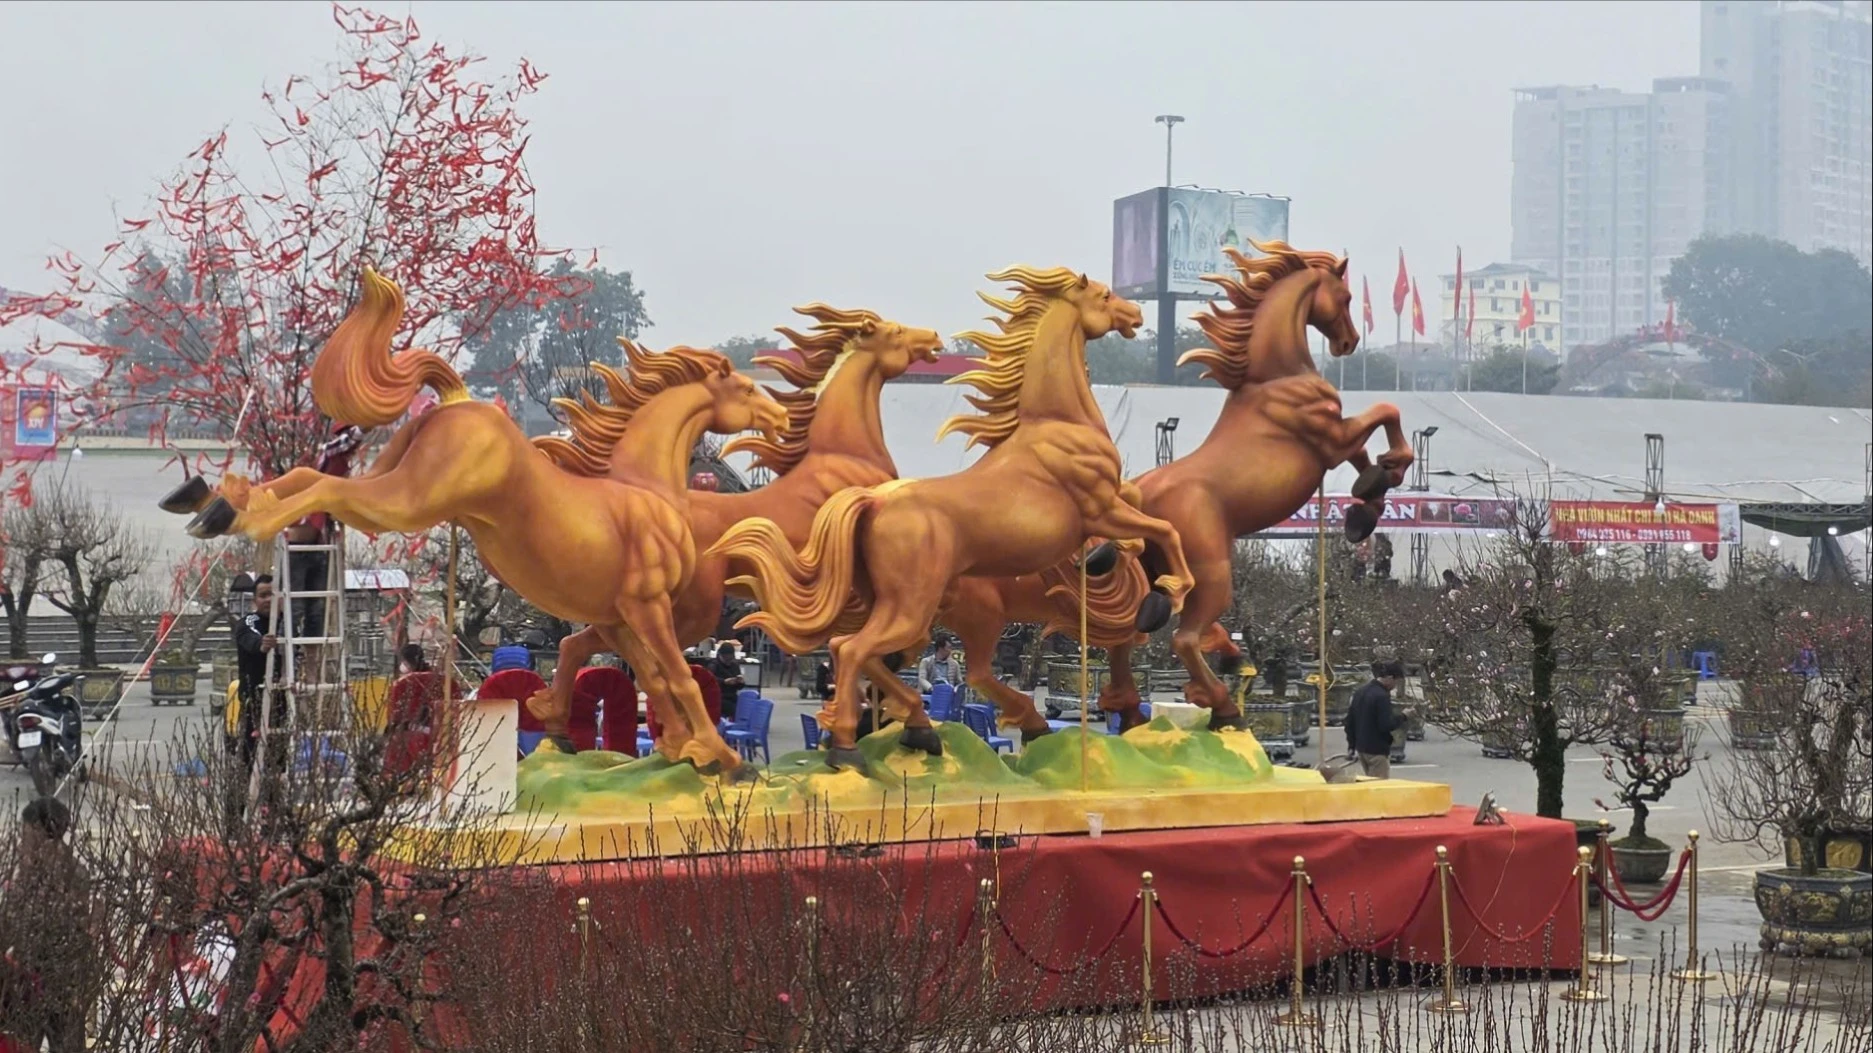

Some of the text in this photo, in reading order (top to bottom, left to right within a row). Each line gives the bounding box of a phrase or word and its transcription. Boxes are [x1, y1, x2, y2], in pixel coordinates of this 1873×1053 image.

[1290, 499, 1416, 524] NHẬ ÂN
[1577, 504, 1604, 522] VƯỜN
[1606, 504, 1632, 523] NHẤT
